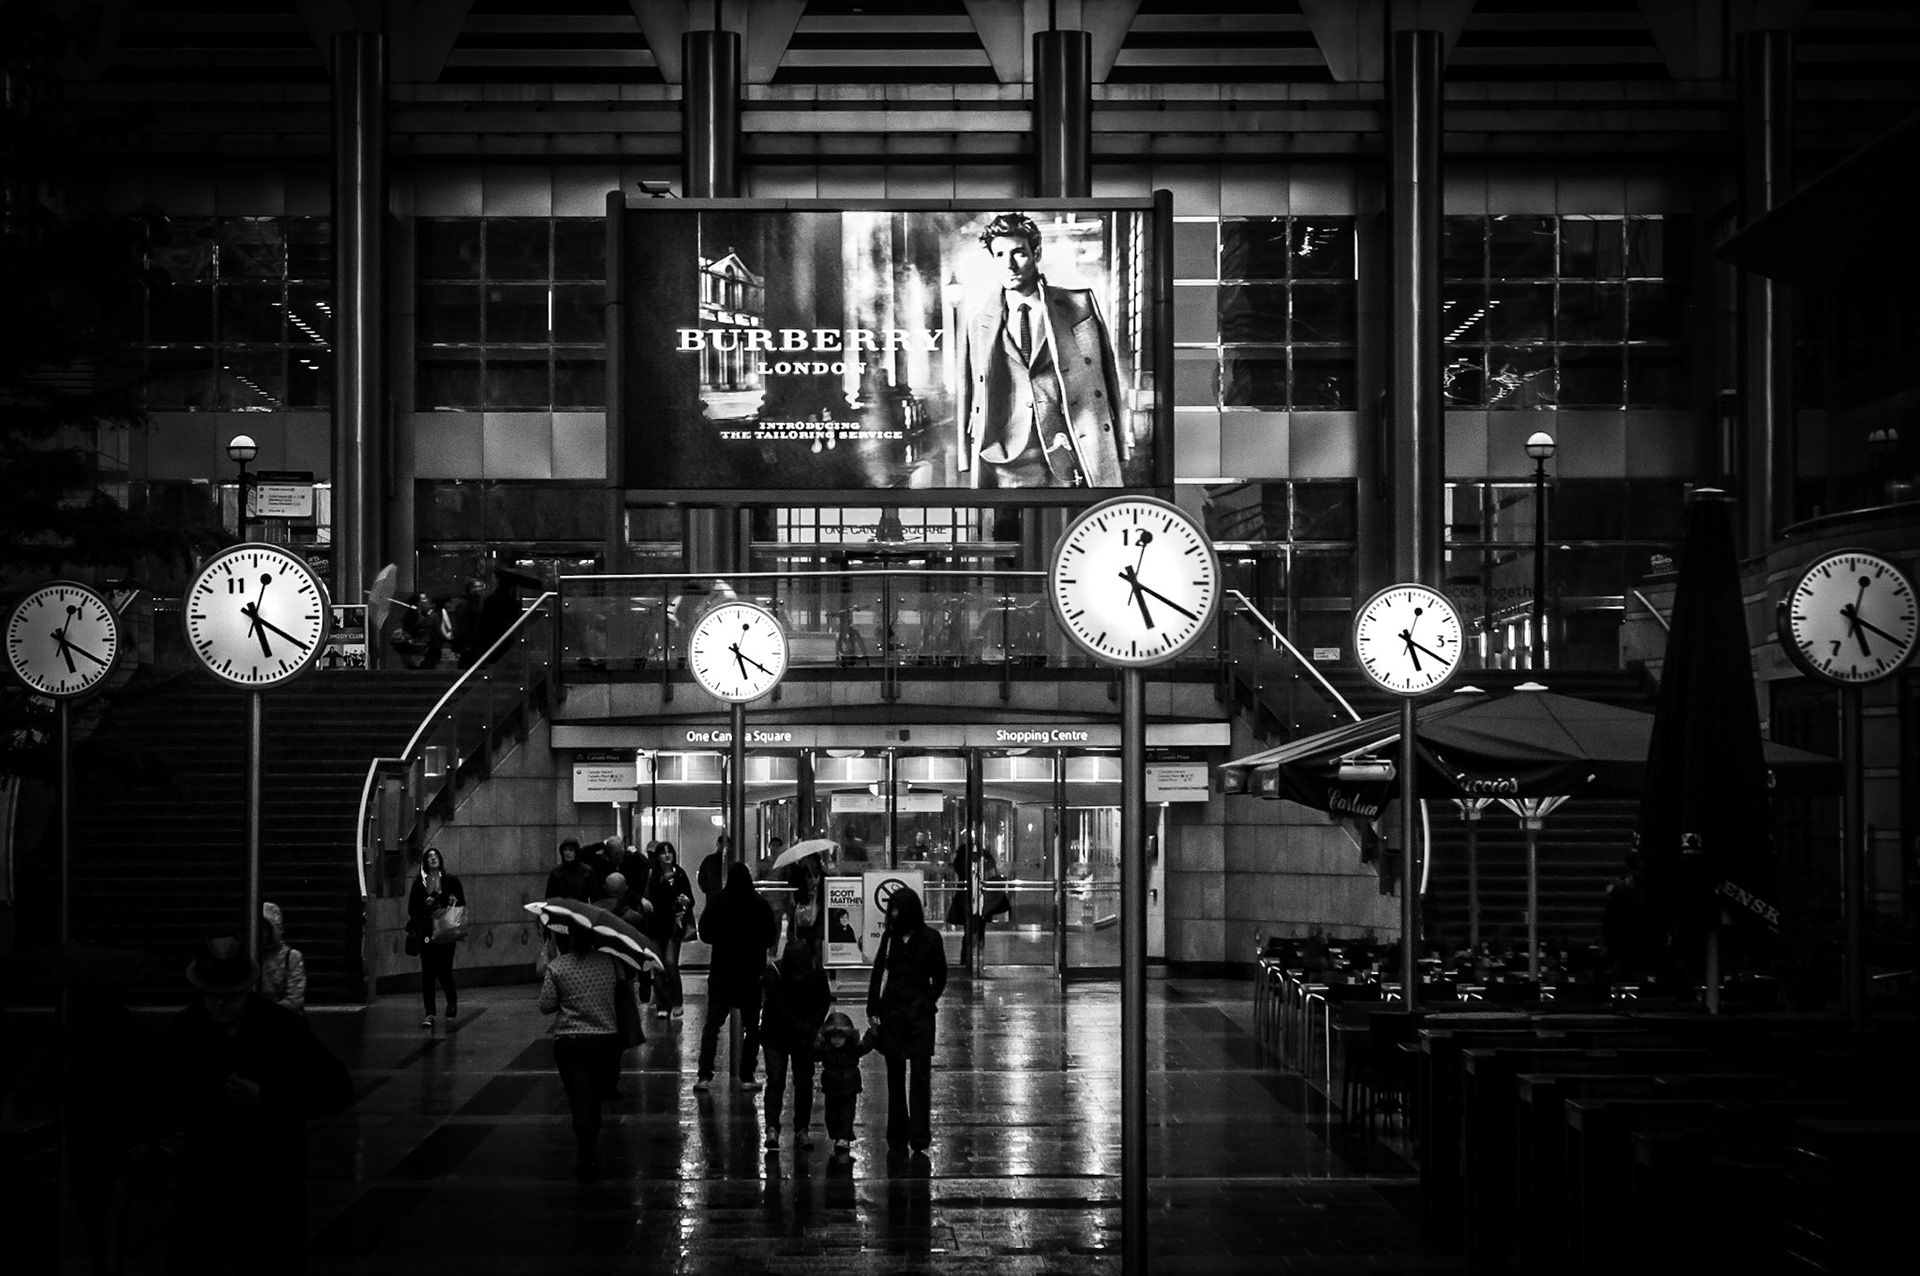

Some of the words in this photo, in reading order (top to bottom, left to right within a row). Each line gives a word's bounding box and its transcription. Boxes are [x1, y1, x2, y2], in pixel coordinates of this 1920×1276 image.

[676, 329, 944, 351] BURBERRY
[757, 362, 867, 375] LONDON
[759, 422, 861, 430] INTRODUCING
[720, 431, 751, 440] THE
[755, 431, 835, 440] TAILORING
[839, 431, 903, 440] SERVICE
[228, 577, 245, 594] 11
[1436, 634, 1445, 648] 3
[1830, 640, 1841, 656] 7
[686, 731, 710, 742] One
[711, 731, 752, 742] Cana
[753, 731, 792, 744] Square
[996, 729, 1050, 743] Shopping
[1051, 729, 1088, 741] Centre
